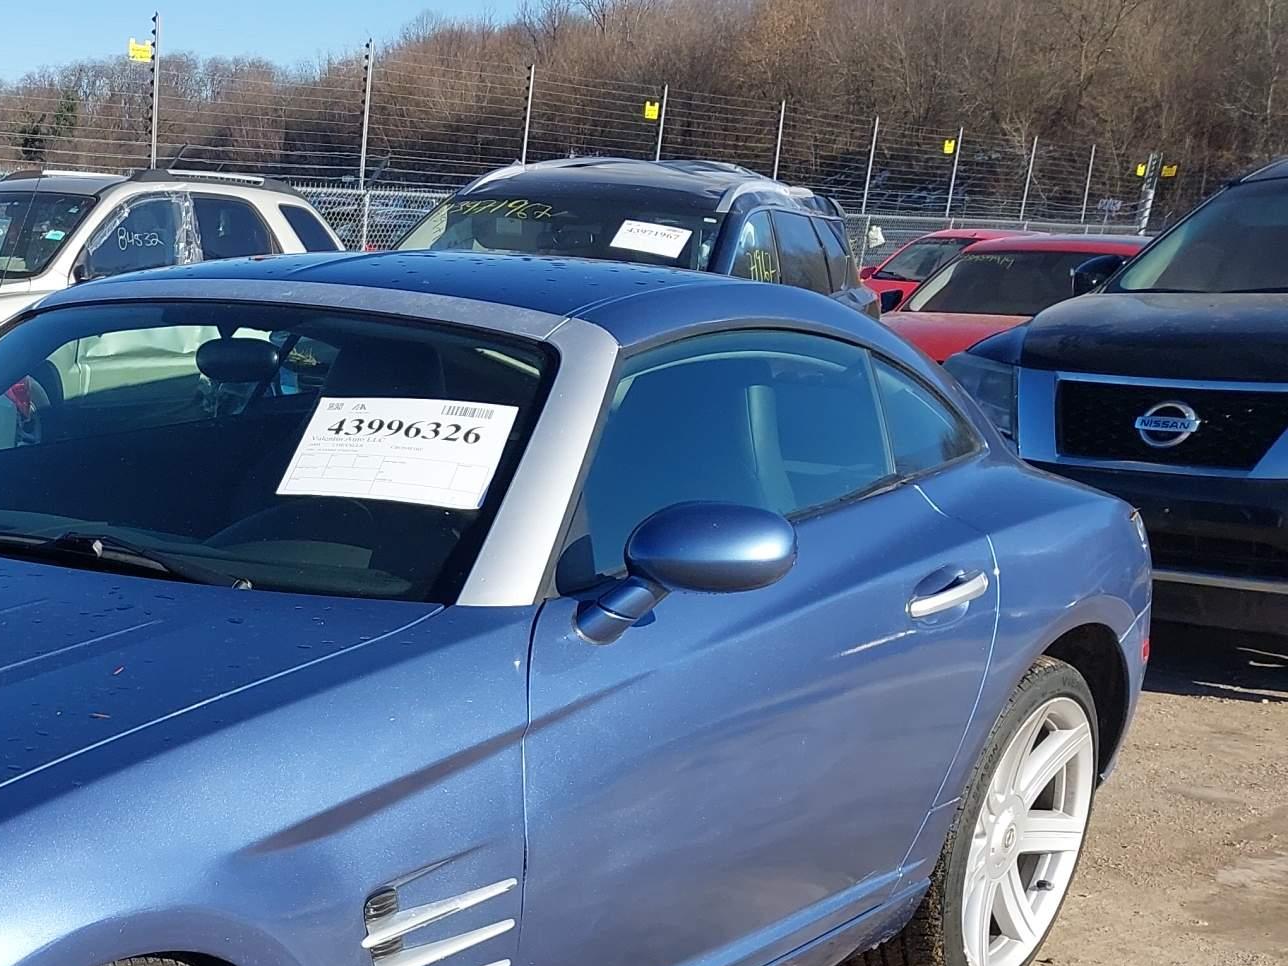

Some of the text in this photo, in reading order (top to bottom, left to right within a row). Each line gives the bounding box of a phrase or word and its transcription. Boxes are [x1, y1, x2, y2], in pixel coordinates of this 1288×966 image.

[117, 226, 167, 251] 84532
[327, 417, 482, 444] 43996326
[1140, 419, 1190, 430] NISSAN
